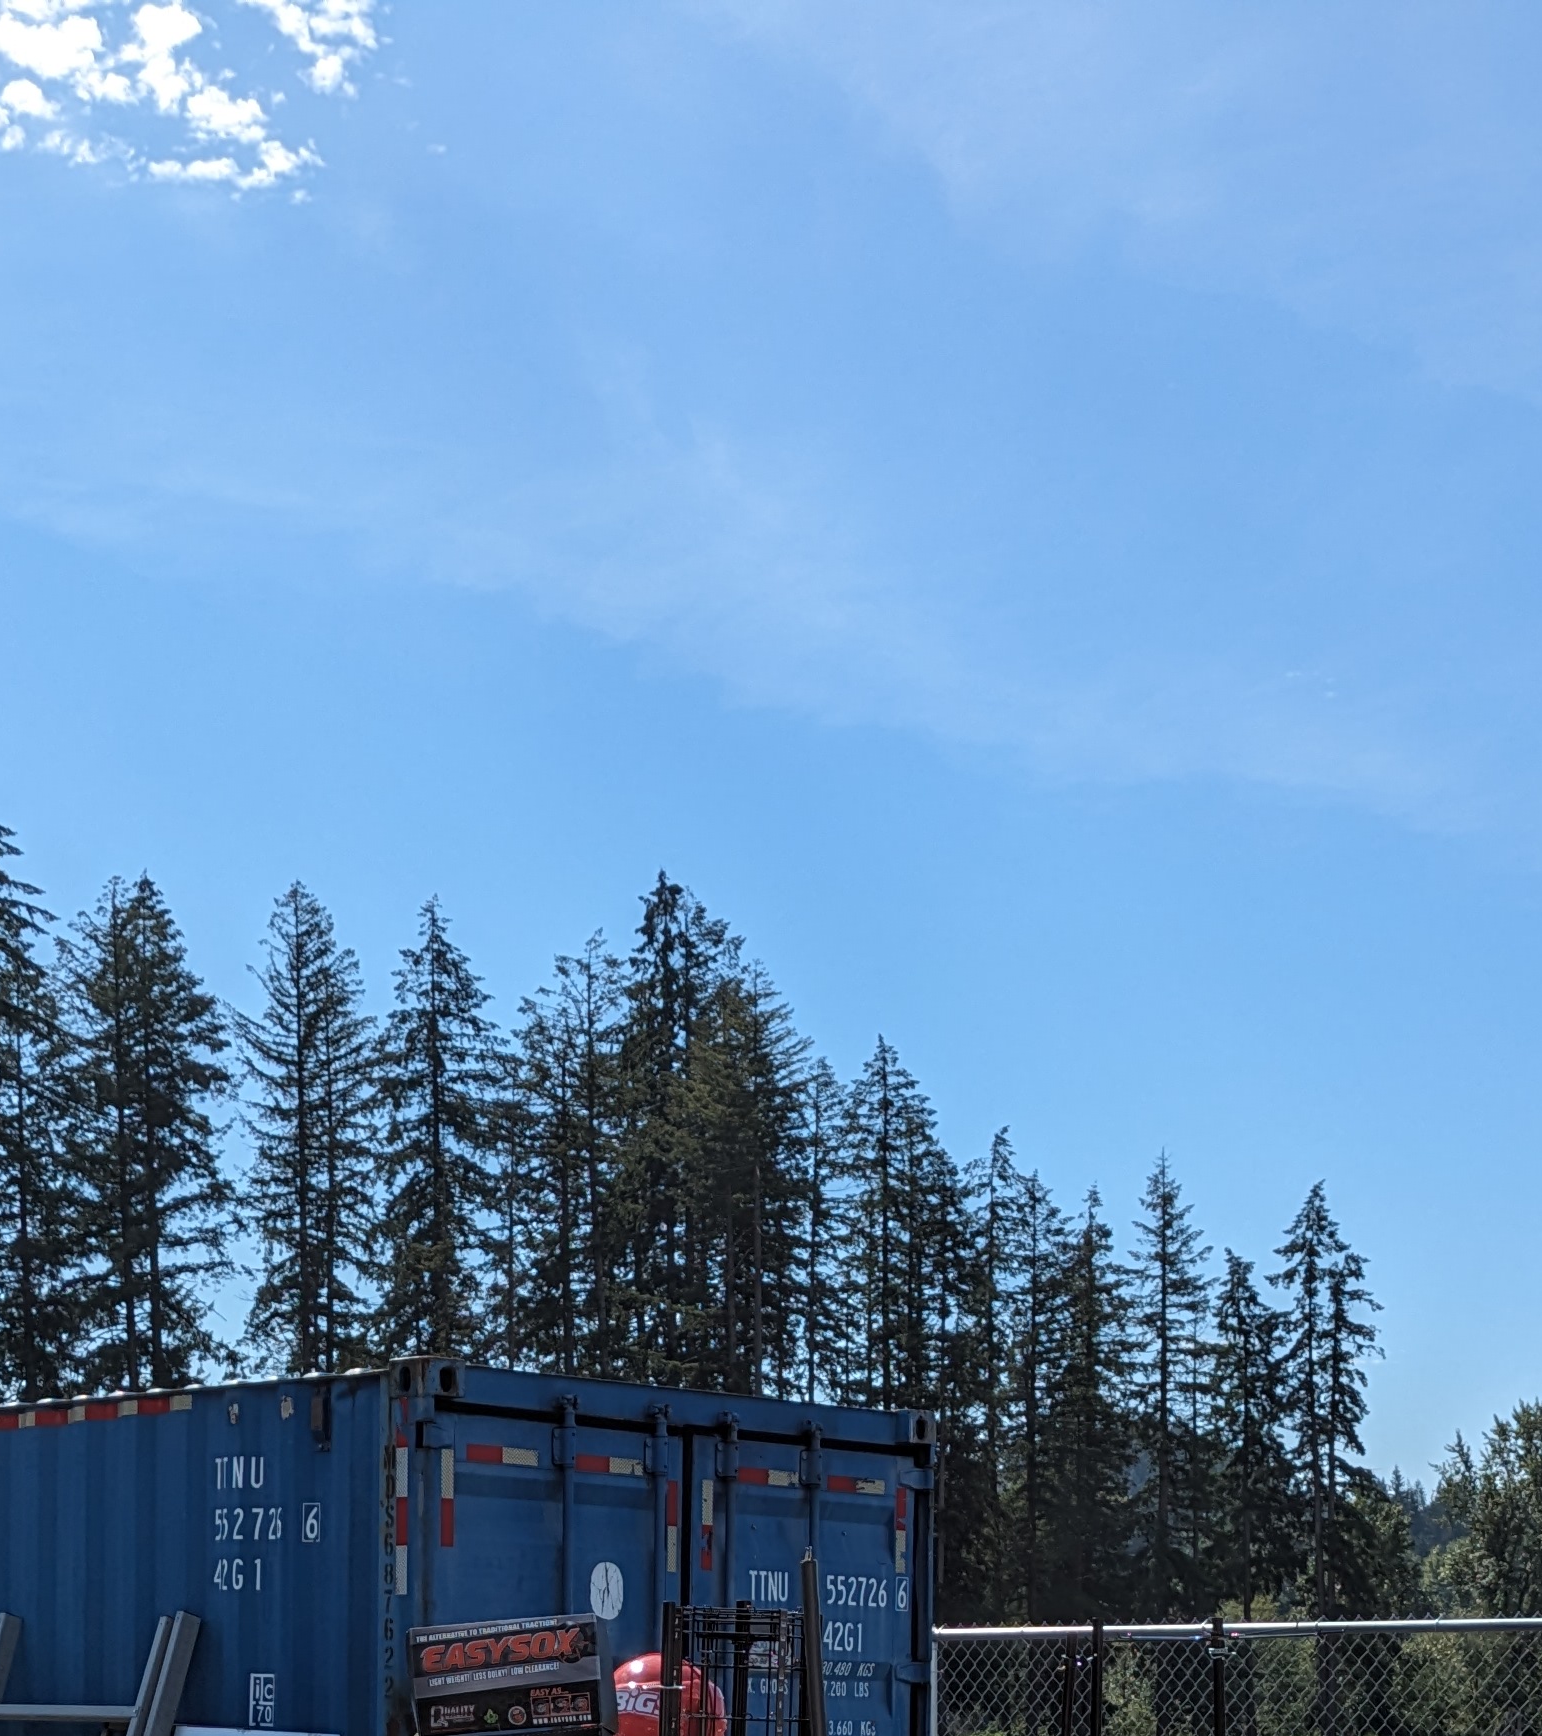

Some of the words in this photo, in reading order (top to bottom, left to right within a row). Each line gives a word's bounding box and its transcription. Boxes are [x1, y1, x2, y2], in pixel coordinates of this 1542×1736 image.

[214, 1456, 265, 1490] TTNU
[214, 1506, 284, 1541] 552726
[303, 1504, 320, 1540] 6
[213, 1558, 262, 1591] 42G1
[749, 1569, 790, 1602] TTNU
[826, 1574, 888, 1608] 552726
[897, 1578, 908, 1610] 6
[469, 1628, 478, 1637] TO
[823, 1621, 864, 1653] 42G1
[421, 1627, 580, 1673] EASYSOX
[473, 1671, 487, 1681] LESS
[511, 1665, 524, 1676] LOW
[856, 1662, 876, 1677] KGS
[854, 1681, 870, 1697] LBS
[256, 1705, 272, 1723] 70
